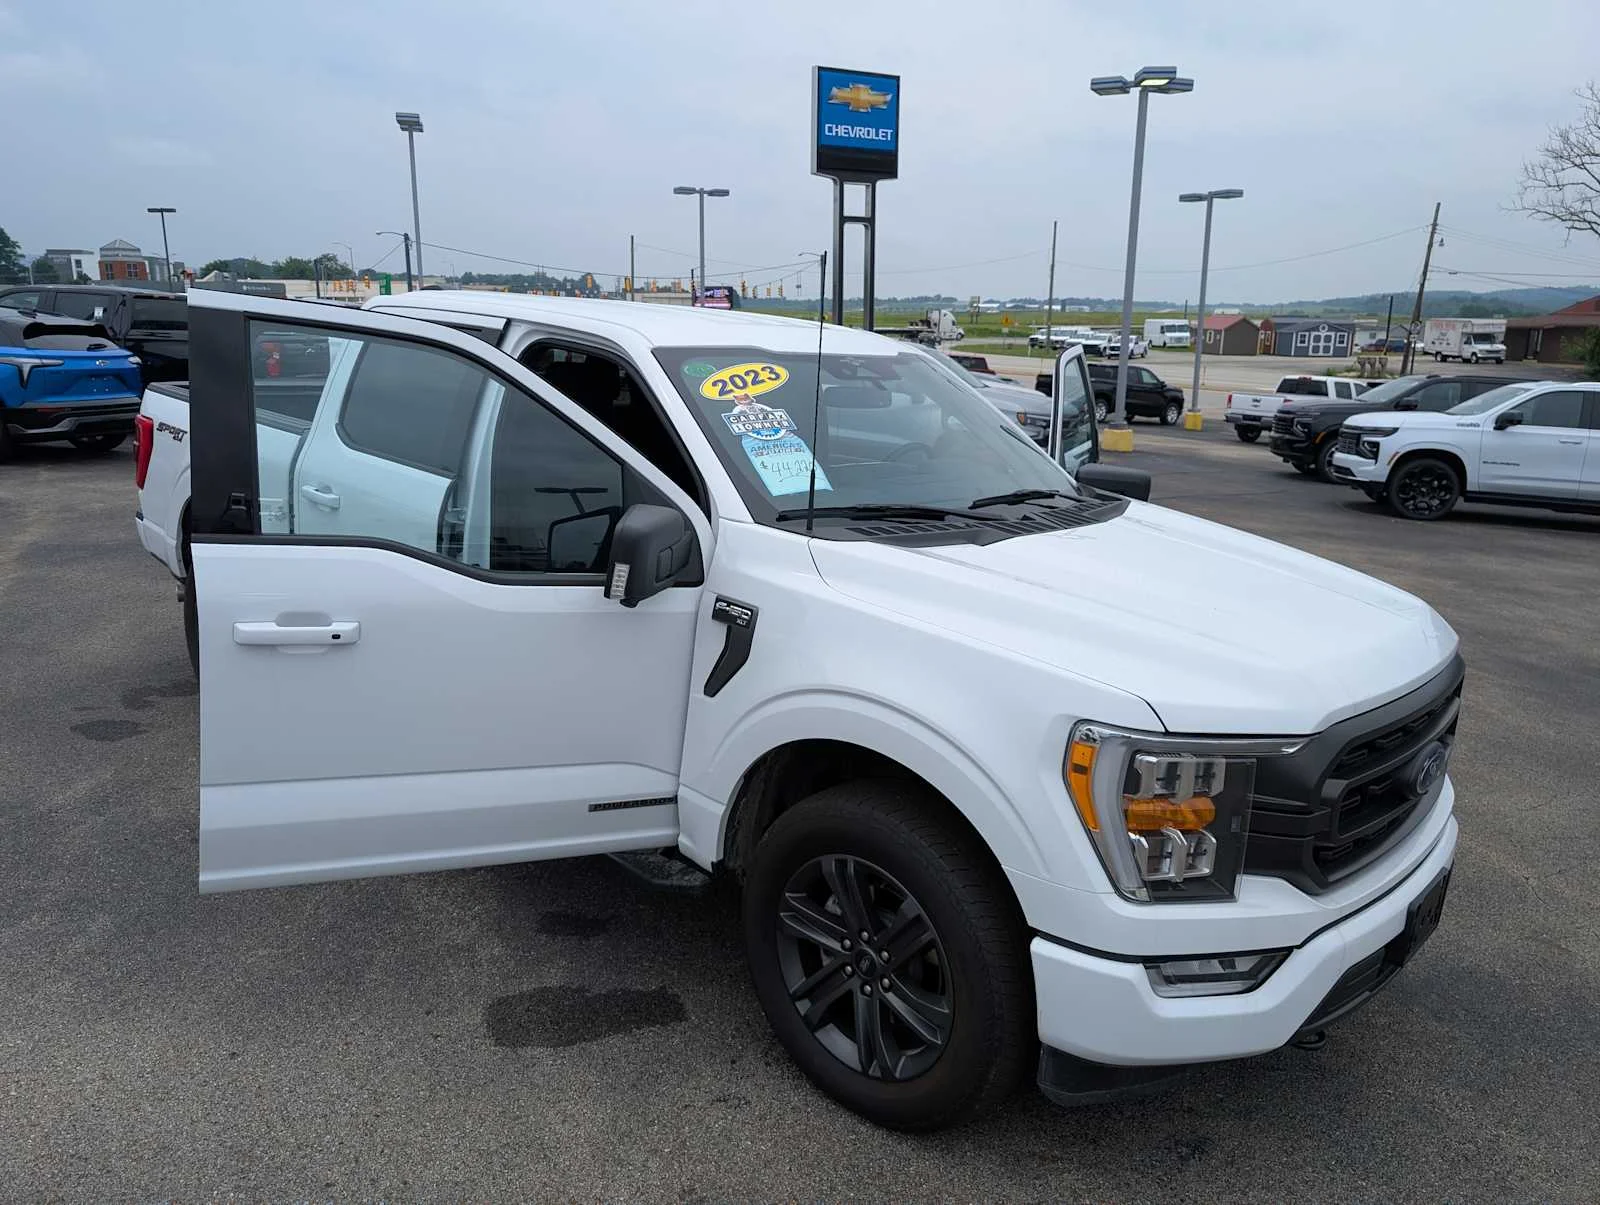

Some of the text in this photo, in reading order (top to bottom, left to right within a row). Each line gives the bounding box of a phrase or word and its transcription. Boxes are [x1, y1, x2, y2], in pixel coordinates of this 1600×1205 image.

[825, 123, 893, 141] CHEVROLET
[711, 366, 781, 397] 2023
[729, 412, 788, 423] CARFAX
[744, 420, 790, 431] OWNER
[156, 421, 188, 441] SPORT
